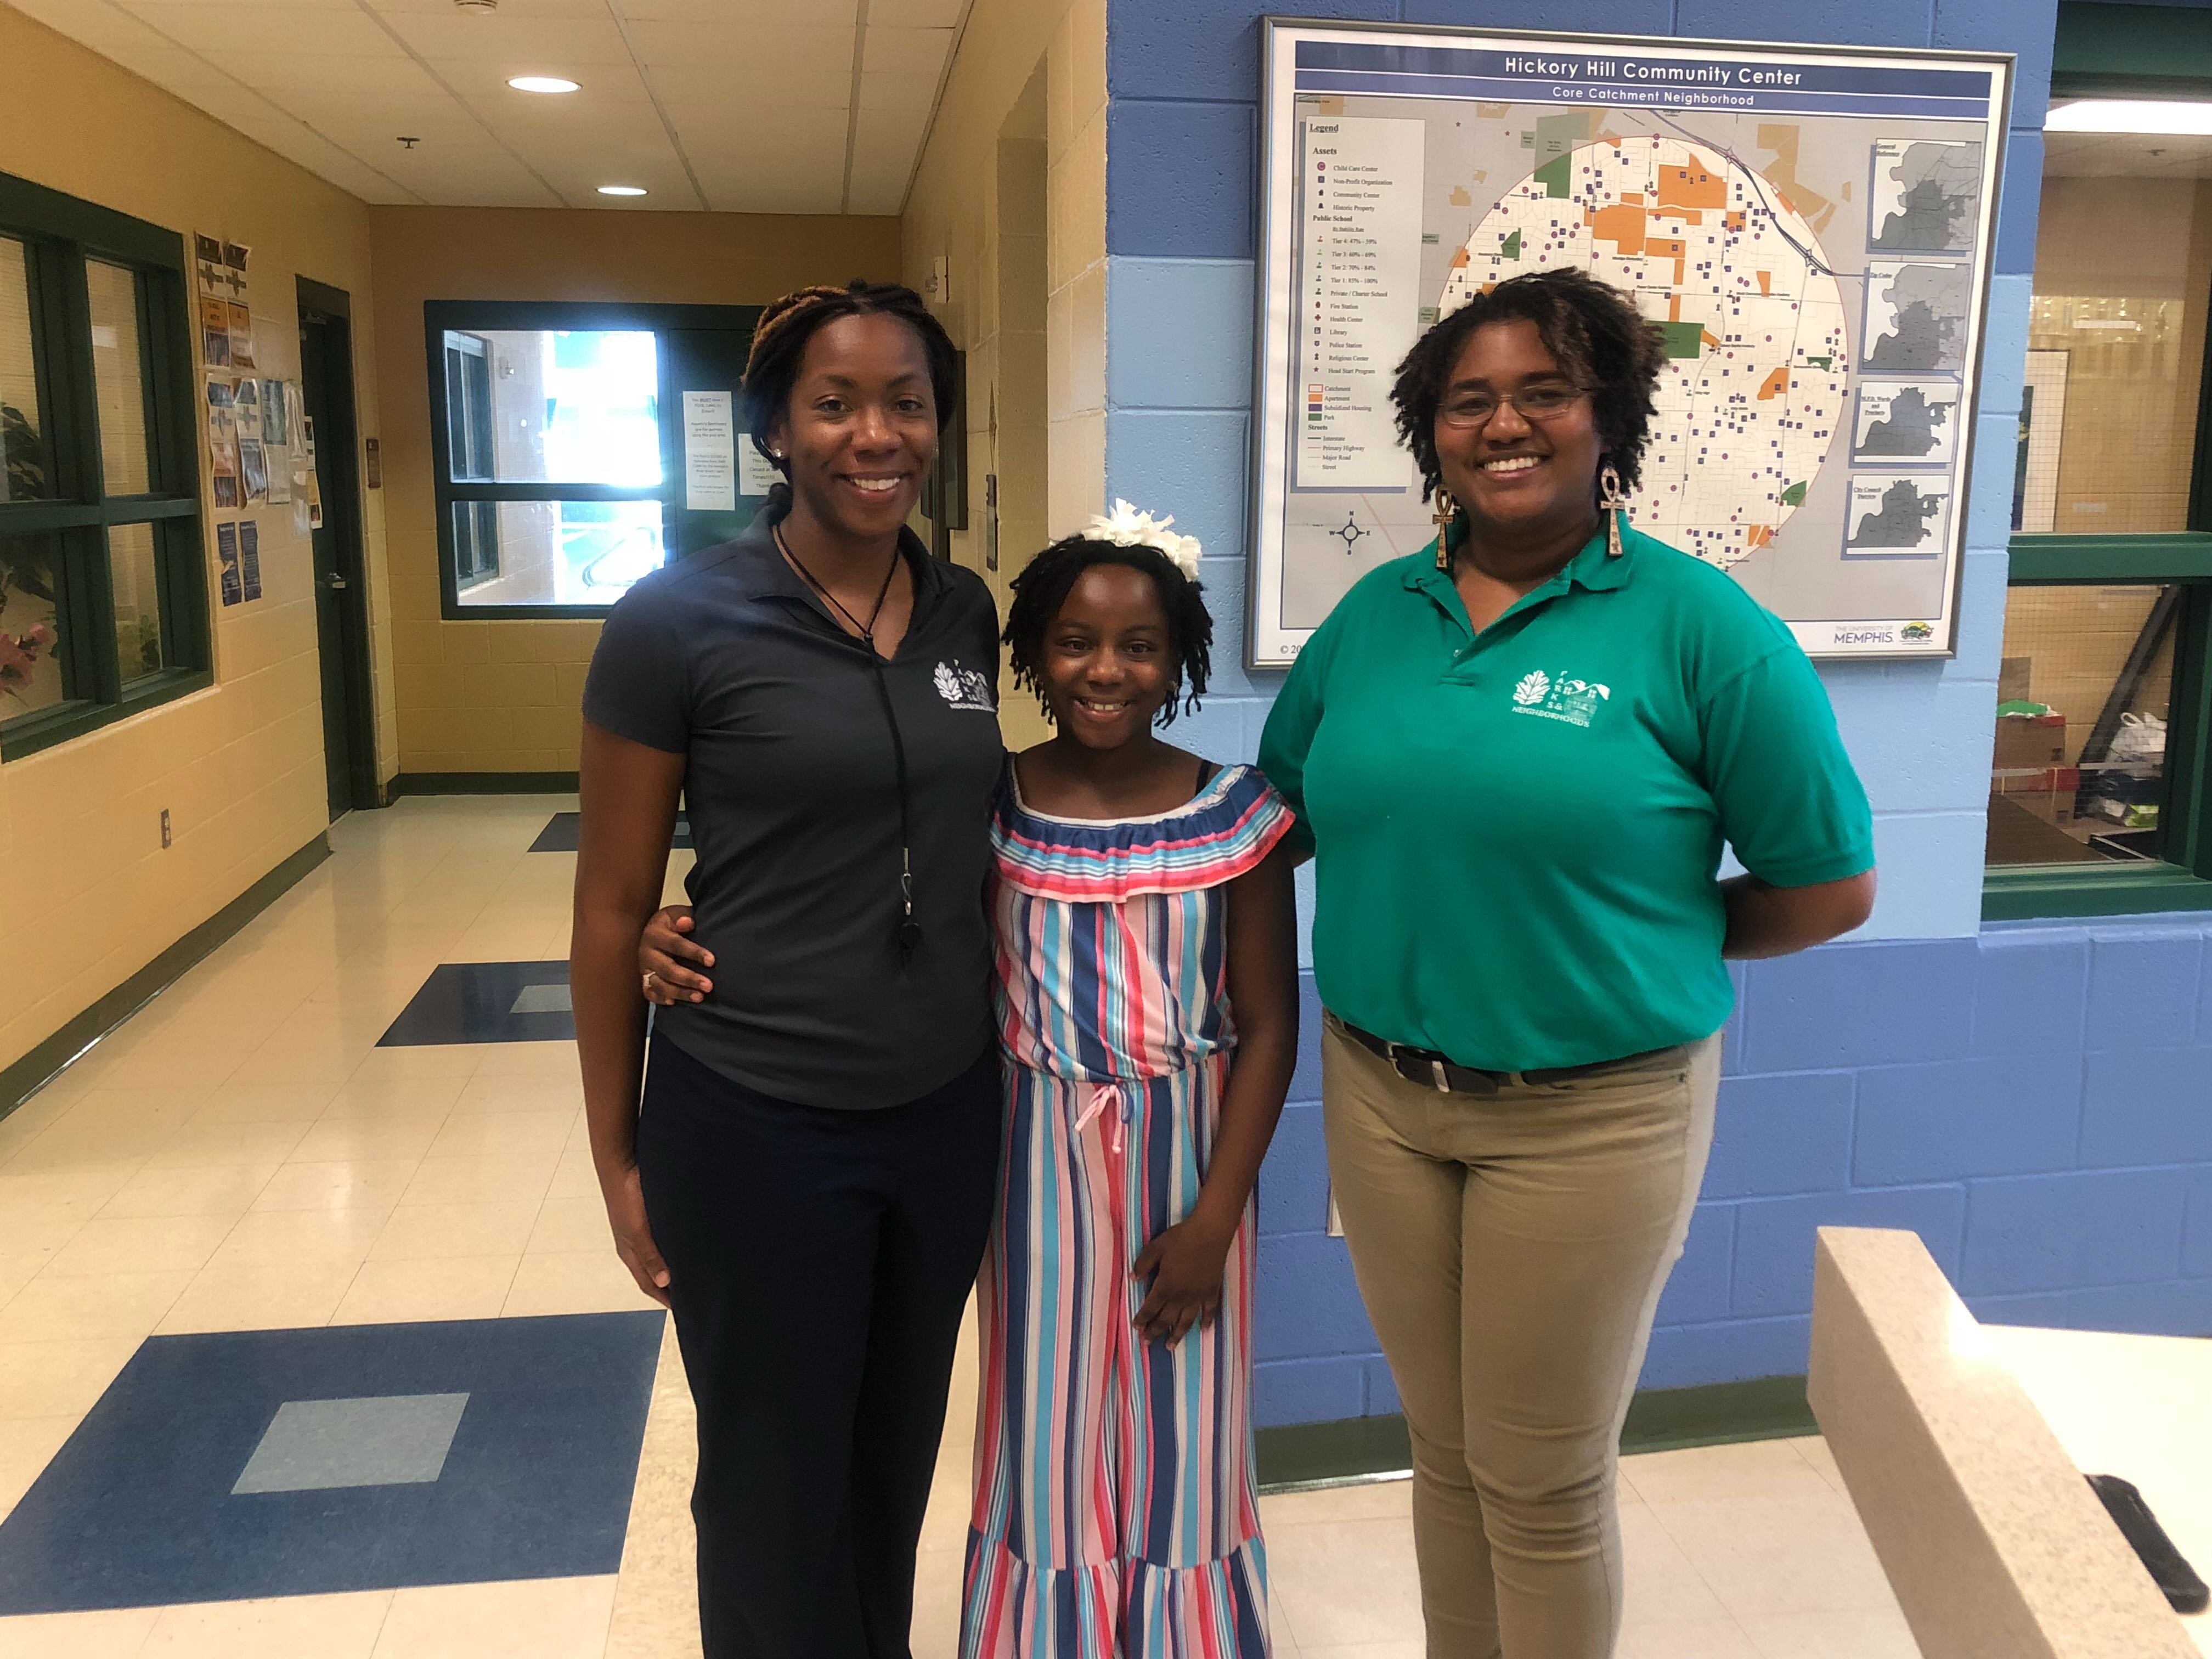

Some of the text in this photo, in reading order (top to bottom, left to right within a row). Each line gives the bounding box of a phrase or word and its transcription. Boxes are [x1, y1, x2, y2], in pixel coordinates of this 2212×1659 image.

[1505, 57, 1801, 85] Hickory Hill Community Center
[1553, 87, 1754, 105] Core Catchment Neighborhood
[1310, 123, 1339, 133] Legend
[1511, 706, 1590, 727] NEIGHBORHOODS
